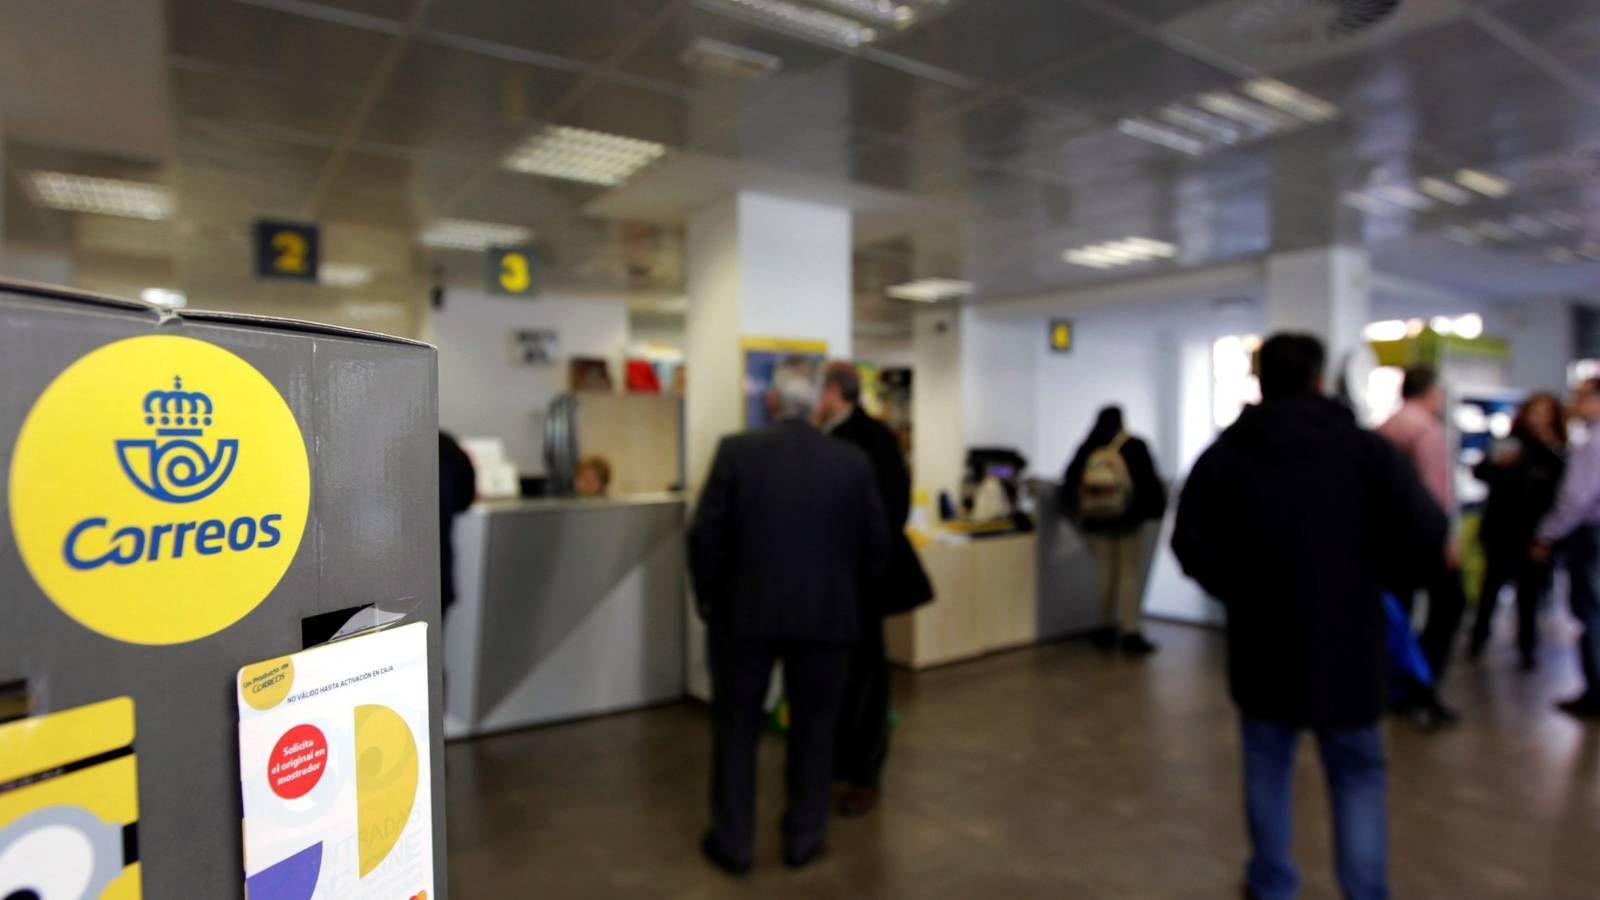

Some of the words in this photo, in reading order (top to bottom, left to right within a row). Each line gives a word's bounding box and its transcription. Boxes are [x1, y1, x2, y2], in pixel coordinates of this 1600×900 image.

[271, 231, 307, 273] 2
[500, 252, 530, 294] 3
[63, 514, 282, 571] Correos
[287, 695, 296, 703] NO
[297, 688, 319, 700] VÁLIDO
[320, 682, 339, 693] HASTA
[340, 672, 372, 687] ACTIVACIÓN
[372, 669, 380, 678] EN
[381, 665, 394, 674] CAJA
[271, 763, 280, 774] el
[281, 750, 314, 769] original
[314, 748, 326, 757] en
[283, 740, 314, 757] Solicita
[277, 762, 320, 786] mostrador
